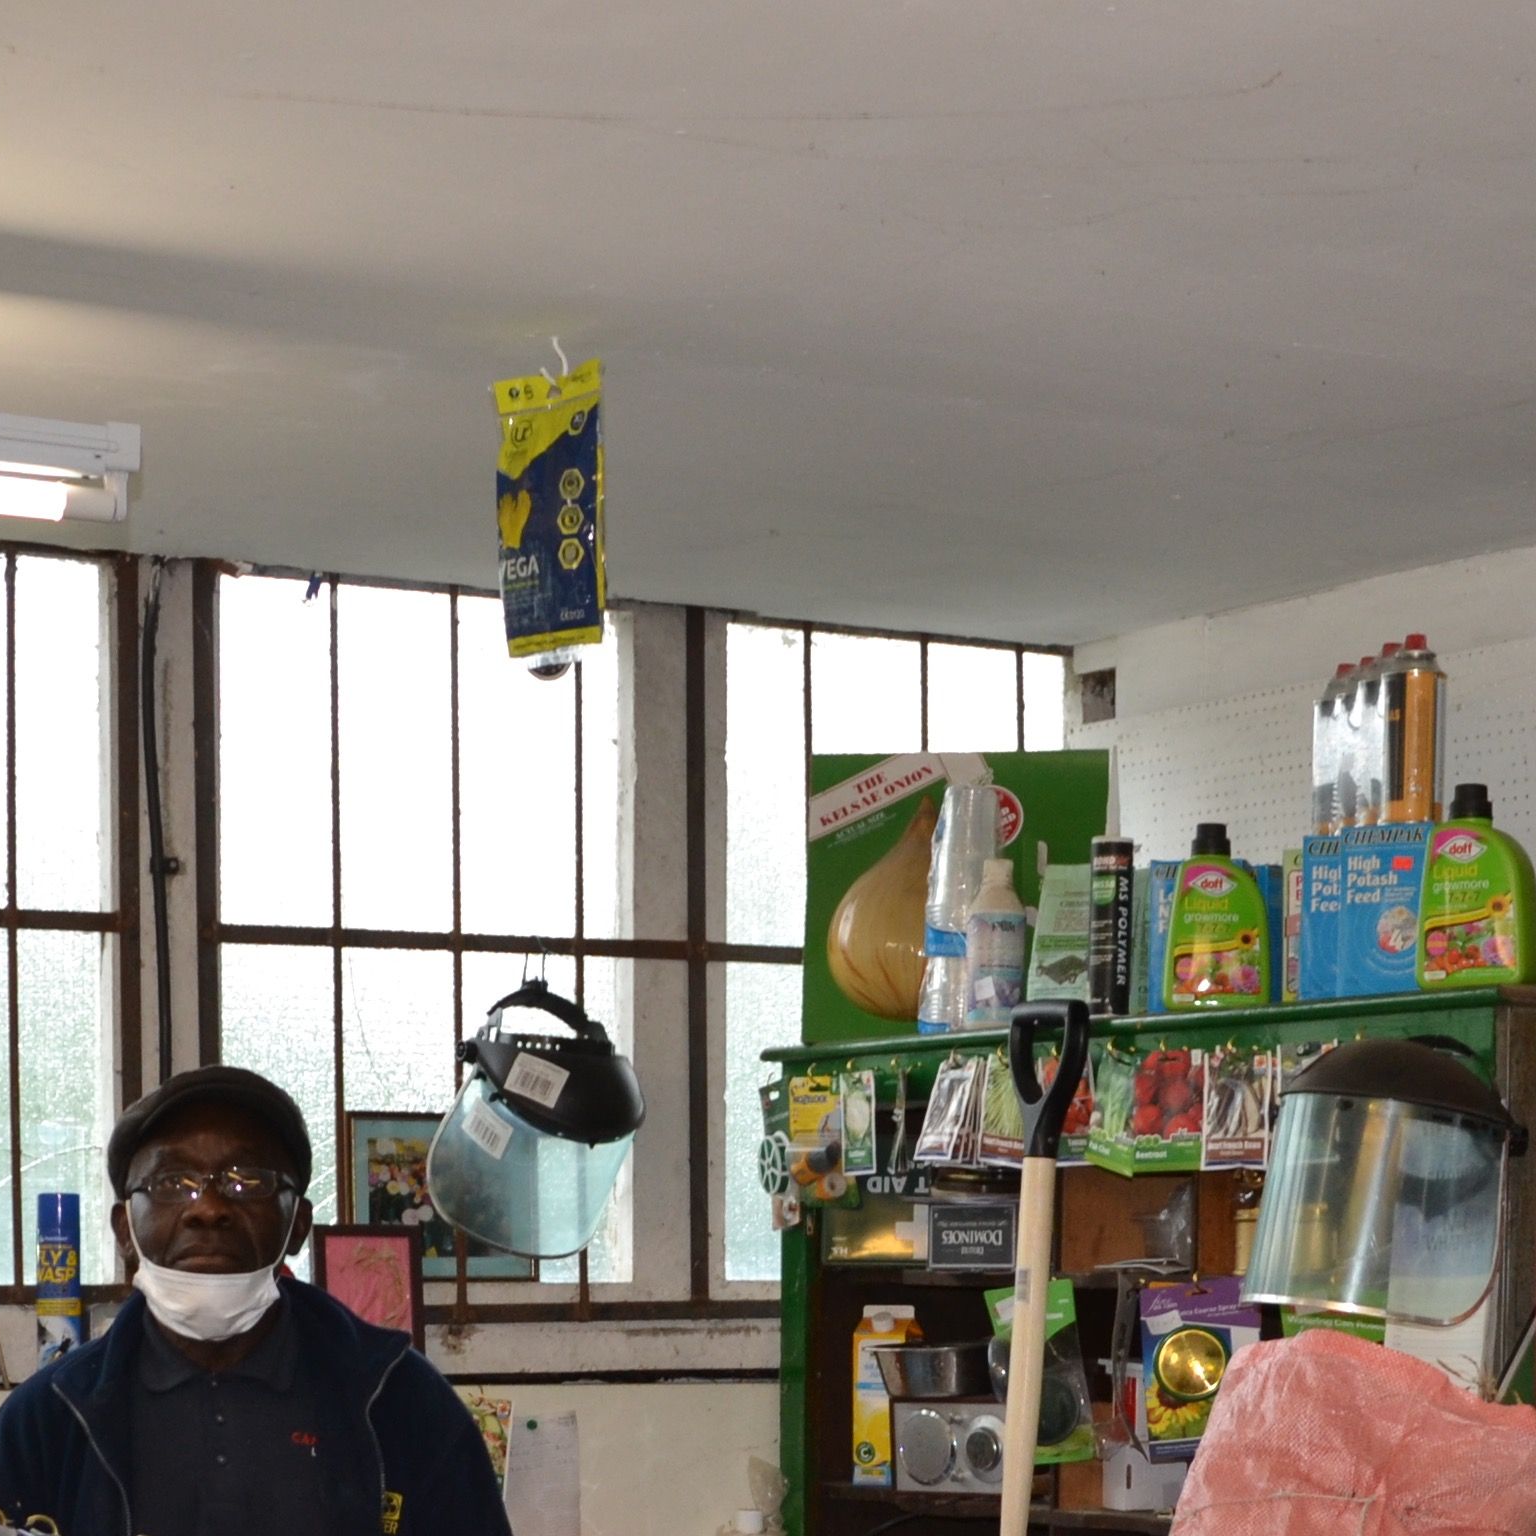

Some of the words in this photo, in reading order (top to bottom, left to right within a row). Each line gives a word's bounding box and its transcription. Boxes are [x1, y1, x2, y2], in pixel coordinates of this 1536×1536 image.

[853, 771, 888, 795] THE
[819, 791, 882, 827] KELSAE
[884, 765, 934, 795] ONION
[1344, 828, 1424, 845] CHEMPAK
[1449, 842, 1472, 855] doff
[1348, 855, 1381, 872] High
[1347, 872, 1398, 887] Potash
[1433, 863, 1478, 882] Liquid
[1117, 875, 1129, 901] MS
[1200, 876, 1224, 889] doff
[1432, 879, 1490, 893] growmore
[1184, 897, 1229, 913] Liquid
[1347, 890, 1381, 905] Feed
[1183, 912, 1240, 924] growmore
[1116, 905, 1129, 986] POLYMER
[941, 1228, 1004, 1246] DOMINOES
